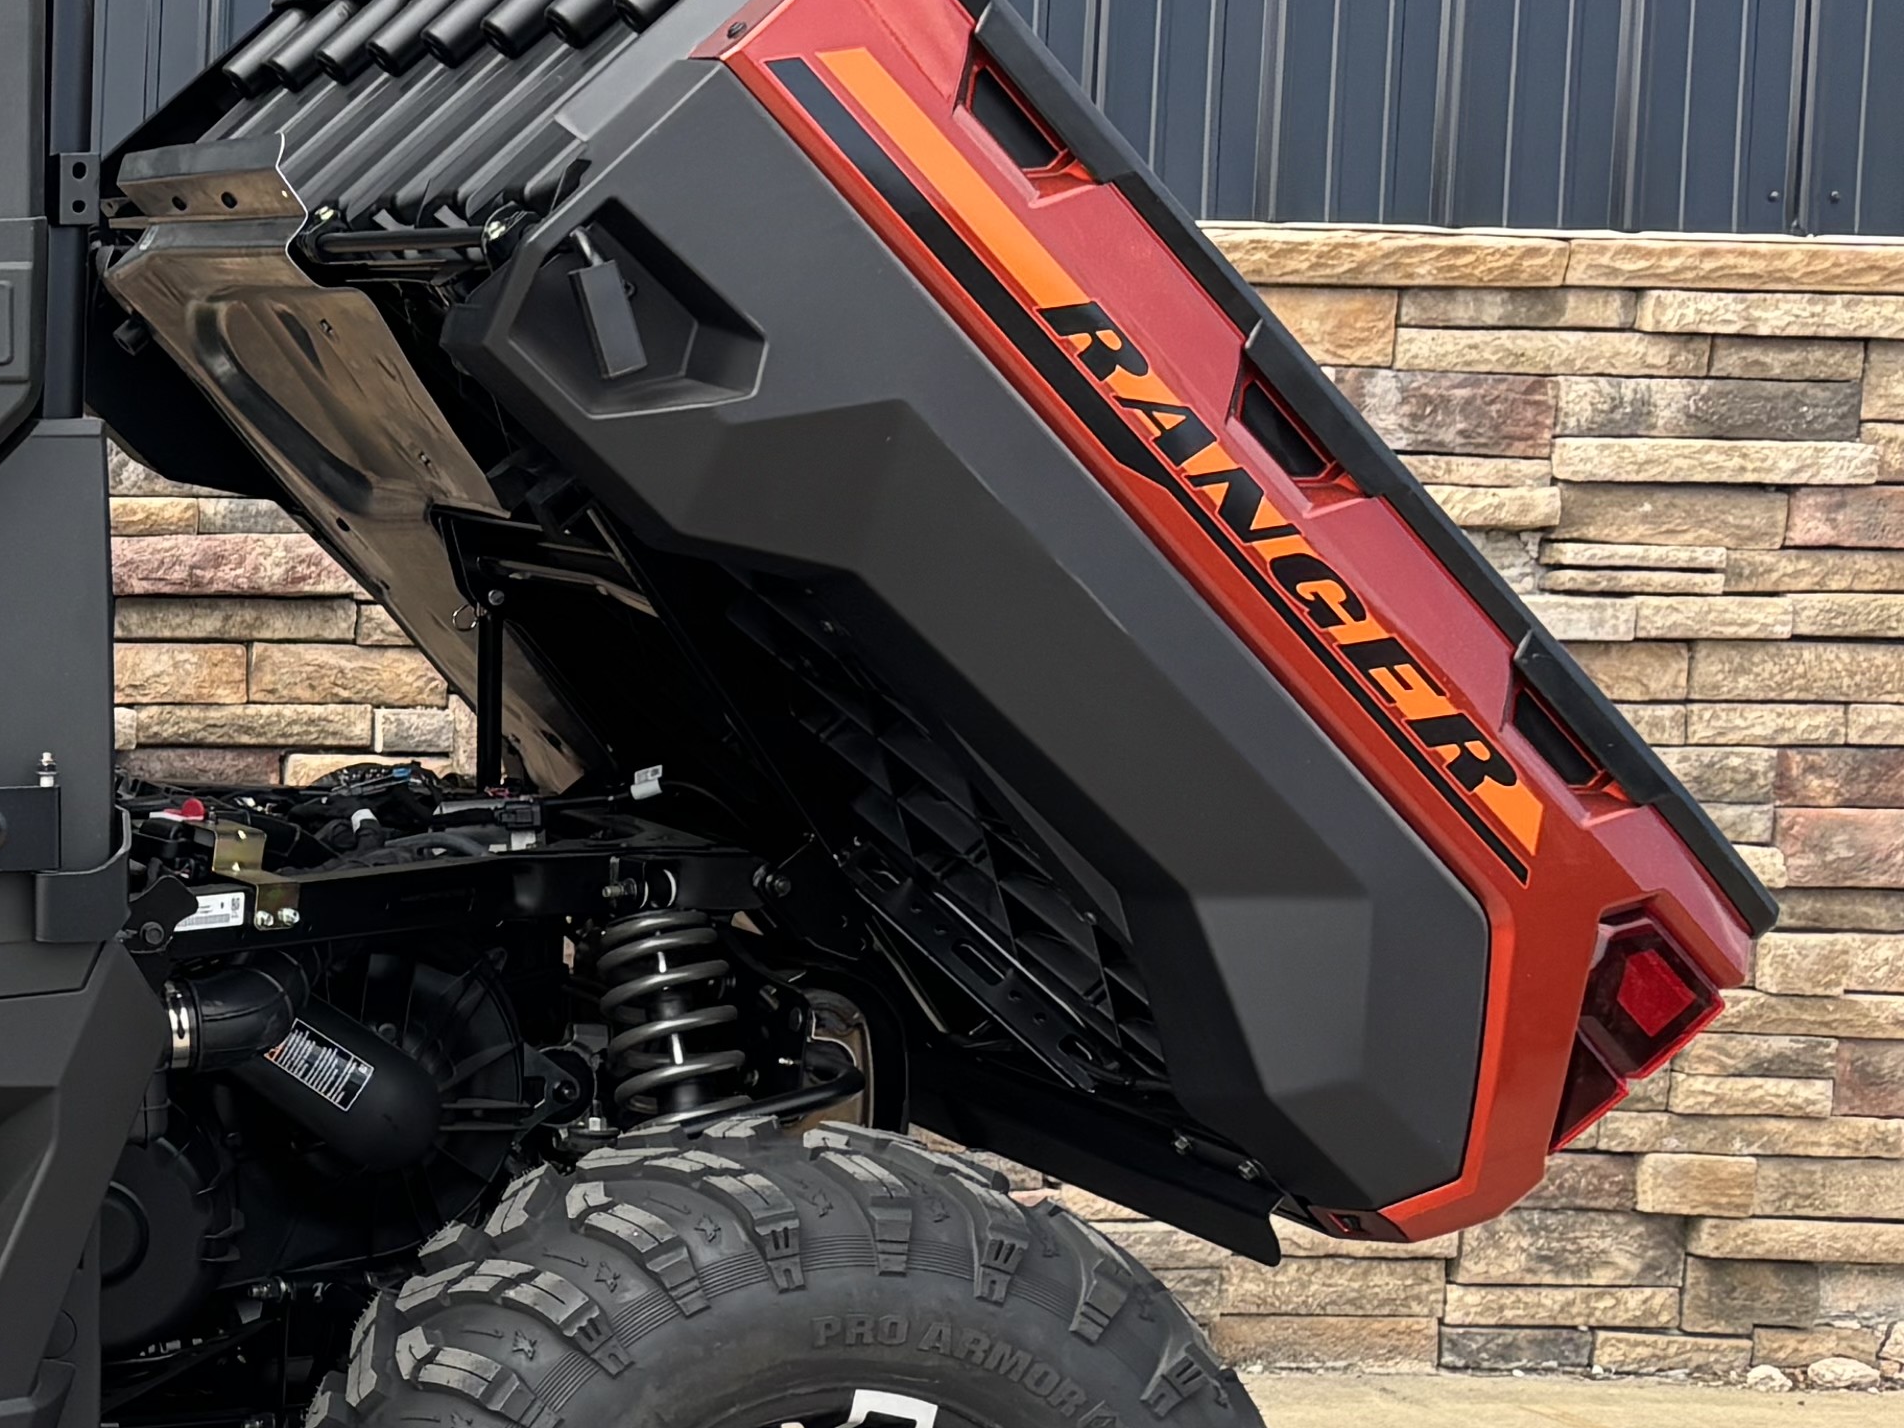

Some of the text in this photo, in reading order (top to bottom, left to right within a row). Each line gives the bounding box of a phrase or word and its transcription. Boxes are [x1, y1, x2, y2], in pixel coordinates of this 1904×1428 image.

[1038, 301, 1517, 793] RANGER
[811, 1314, 1088, 1417] PRO ARMOR
